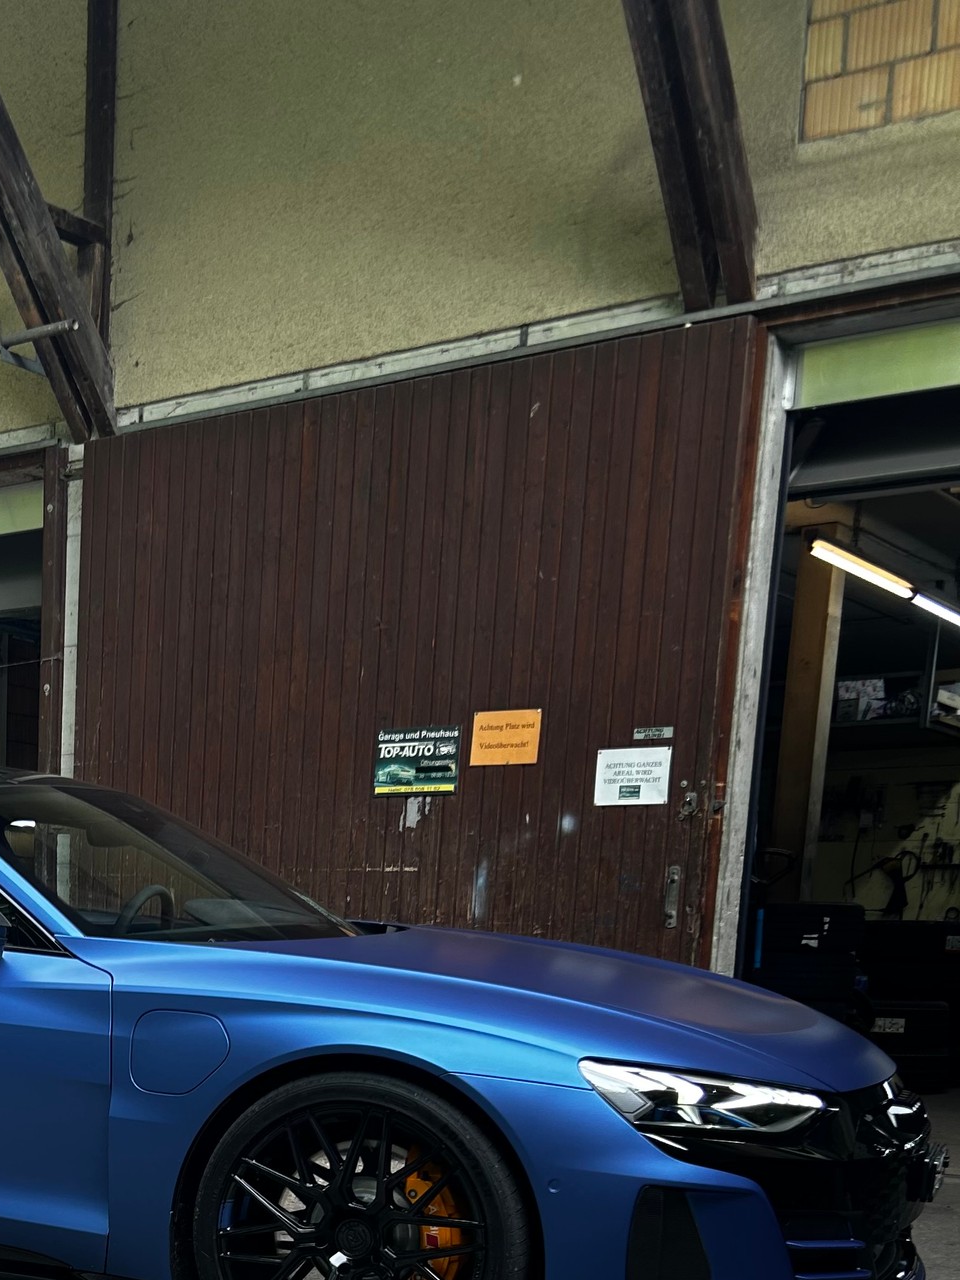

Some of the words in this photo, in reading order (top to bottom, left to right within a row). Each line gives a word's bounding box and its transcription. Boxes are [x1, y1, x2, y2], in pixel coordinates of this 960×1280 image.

[479, 723, 504, 732] Achtung
[378, 731, 404, 741] Garage
[406, 731, 420, 739] und
[421, 729, 459, 738] Pneuhaus
[378, 741, 435, 758] TOP-AUTO
[636, 761, 662, 769] GANZES
